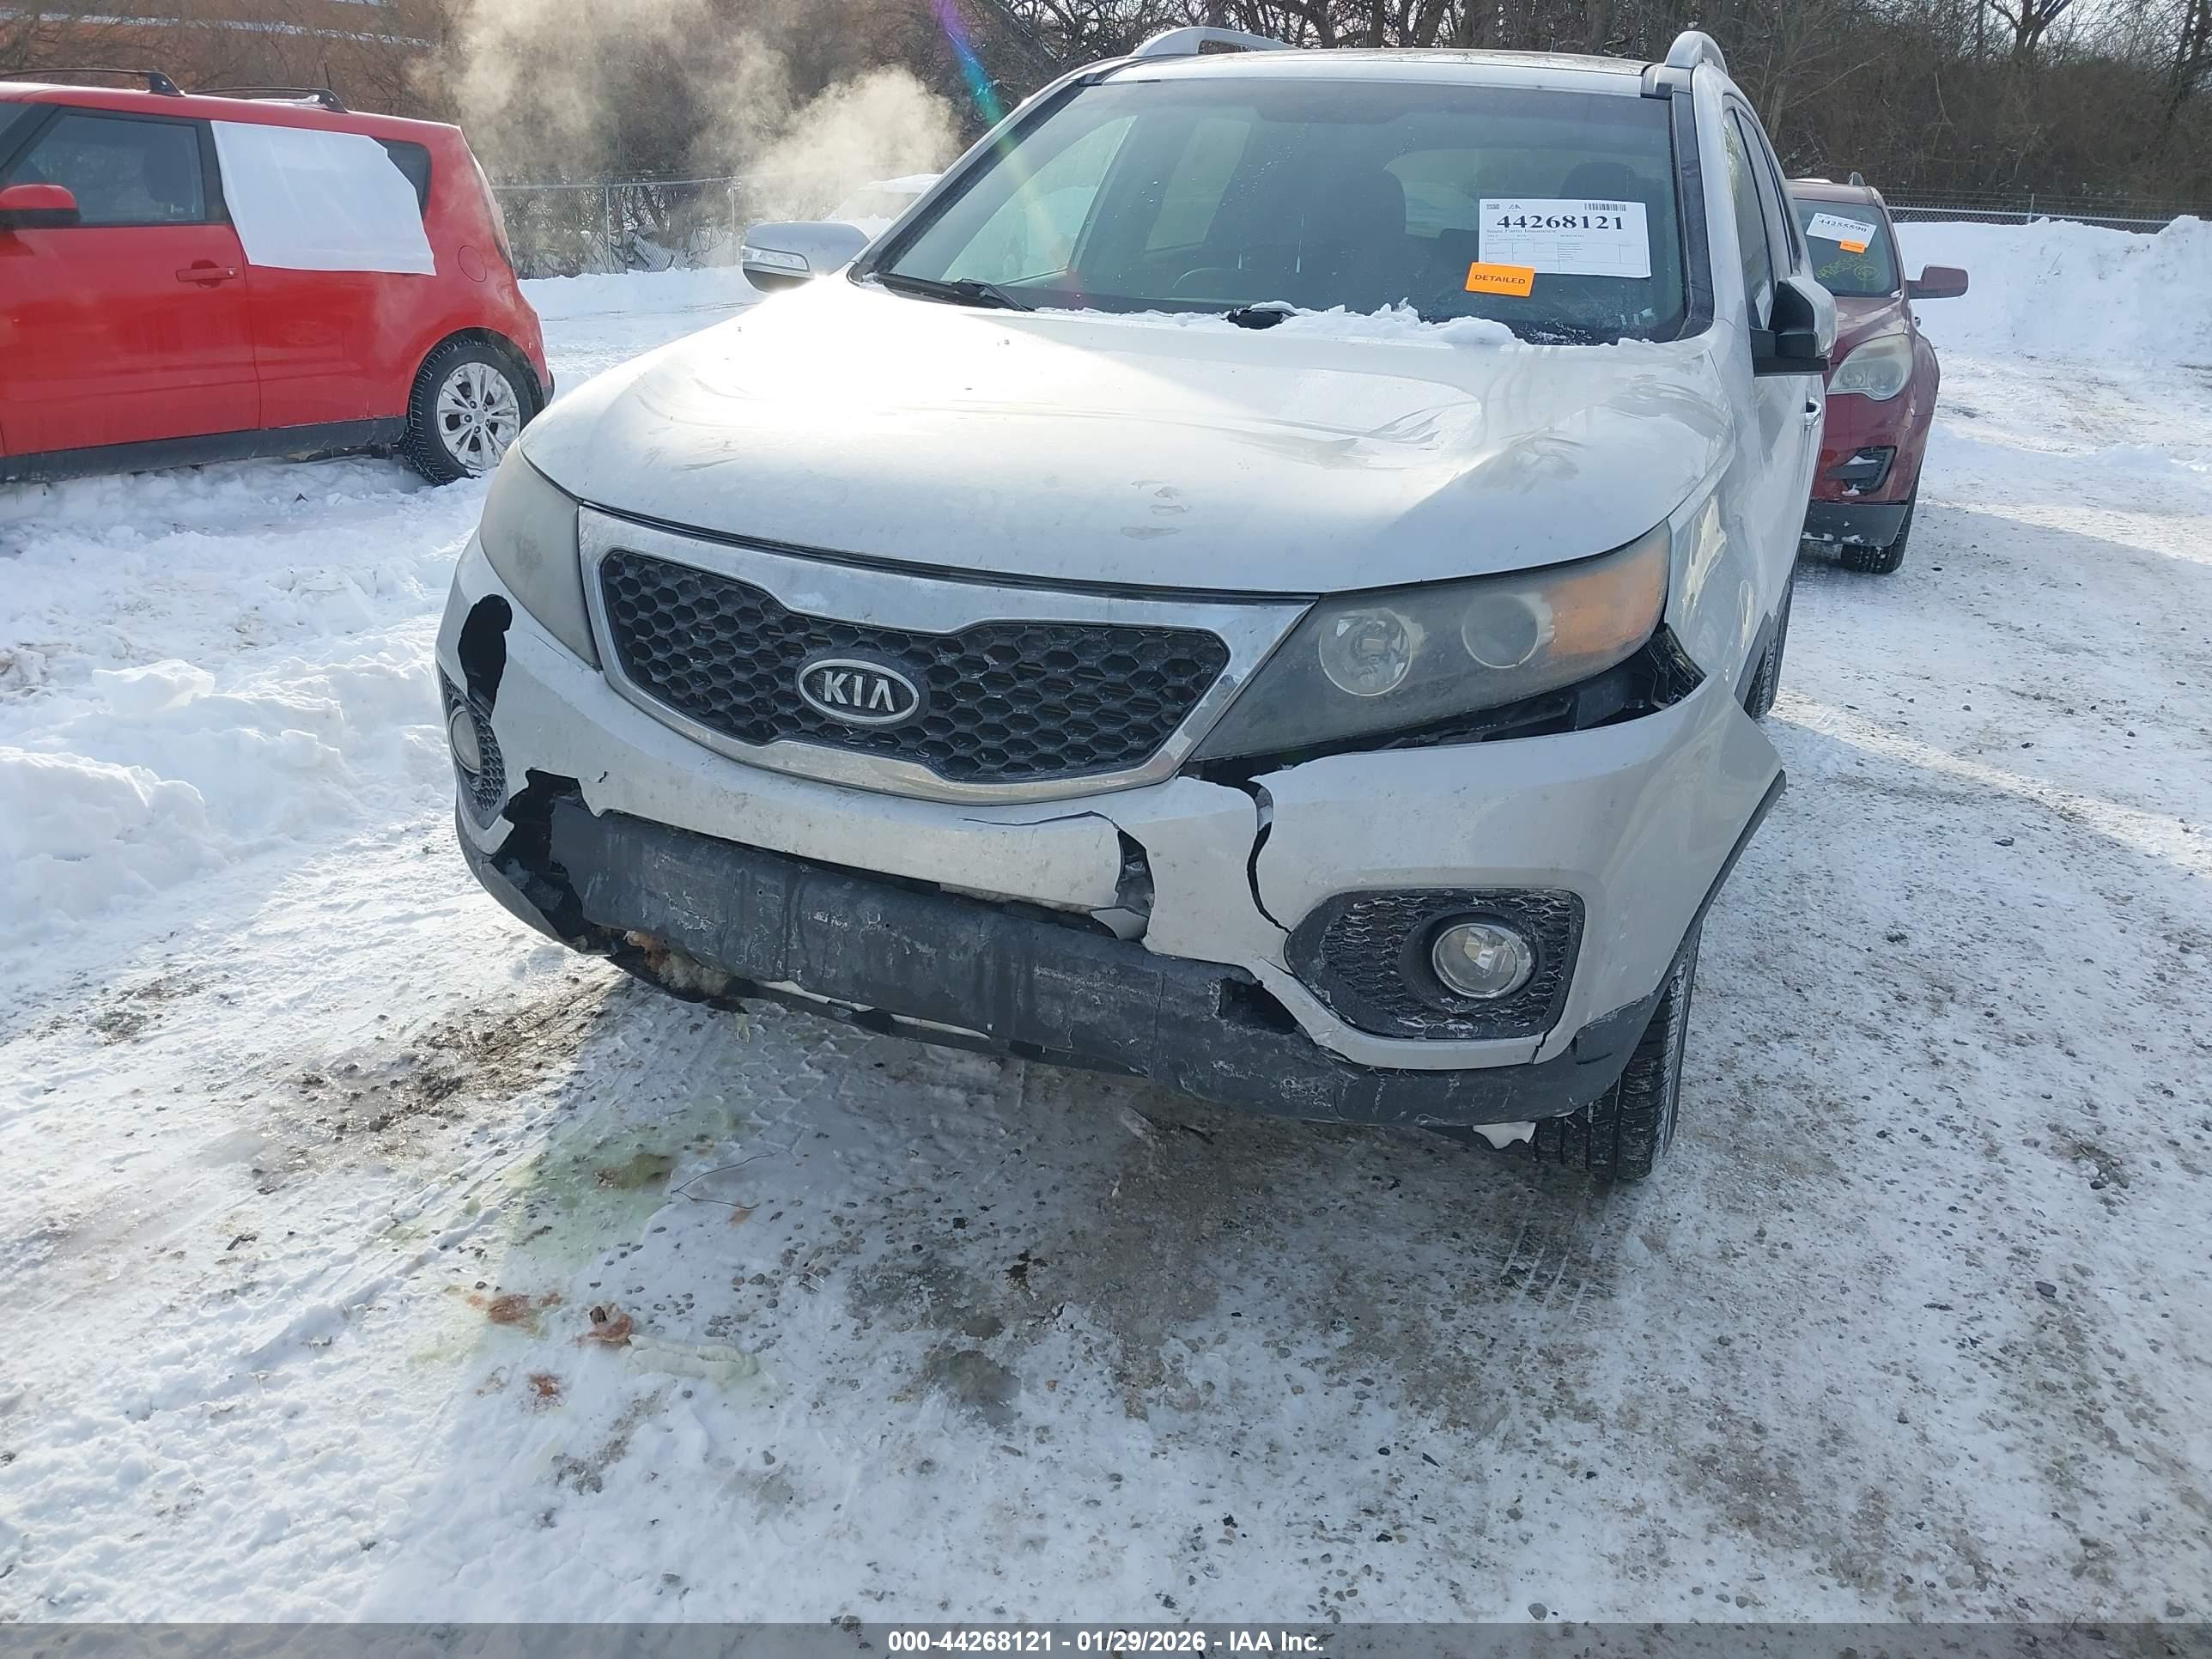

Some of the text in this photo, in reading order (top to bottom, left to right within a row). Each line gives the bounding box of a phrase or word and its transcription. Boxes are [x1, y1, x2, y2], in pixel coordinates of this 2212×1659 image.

[1497, 215, 1624, 229] 44268121
[1474, 274, 1526, 285] DETAILED
[823, 671, 895, 712] KIA
